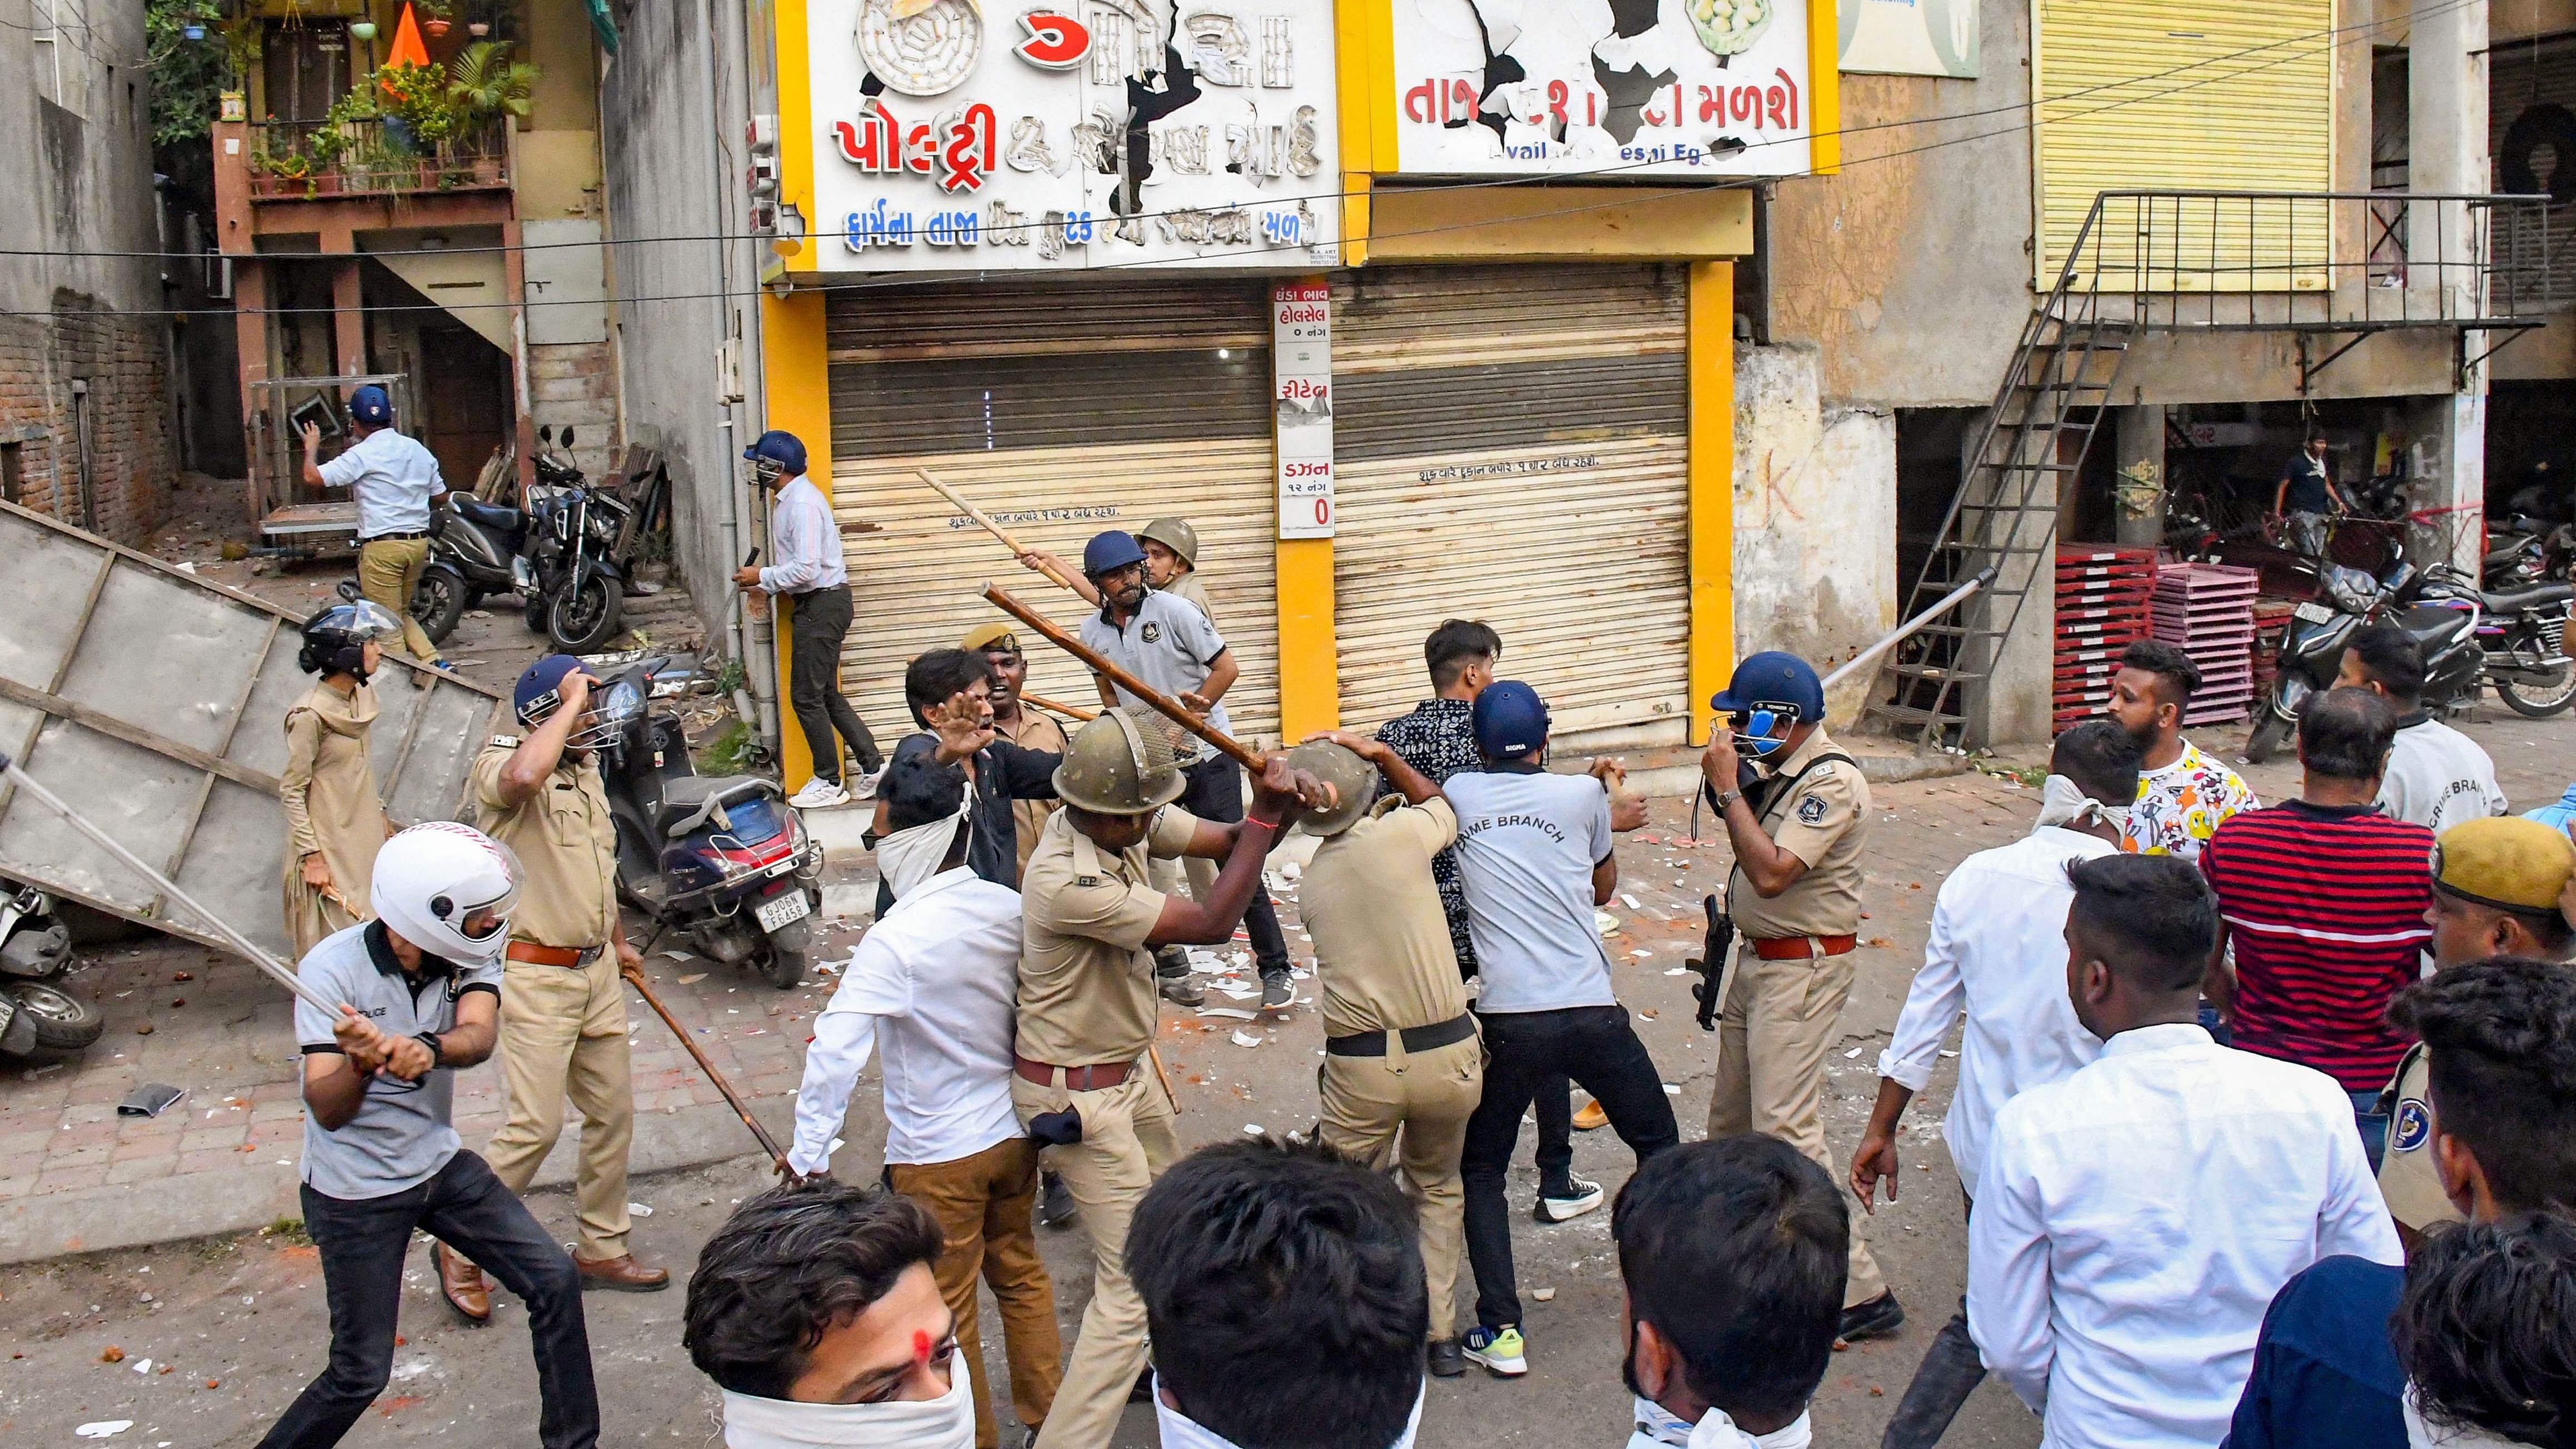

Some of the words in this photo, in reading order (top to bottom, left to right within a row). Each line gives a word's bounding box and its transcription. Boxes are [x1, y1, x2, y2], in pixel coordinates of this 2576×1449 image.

[1699, 67, 1798, 129] મળશે
[1302, 290, 1328, 301] ભાવ
[1280, 304, 1325, 324] હોલસેલ
[1307, 326, 1326, 337] નંગ
[1285, 462, 1329, 477] ડઝન
[1307, 480, 1326, 491] નંગ
[1505, 743, 1526, 751] SIGMA
[1497, 815, 1565, 844] BRANCH
[766, 894, 798, 917] GJ06N
[770, 905, 803, 928] F6458
